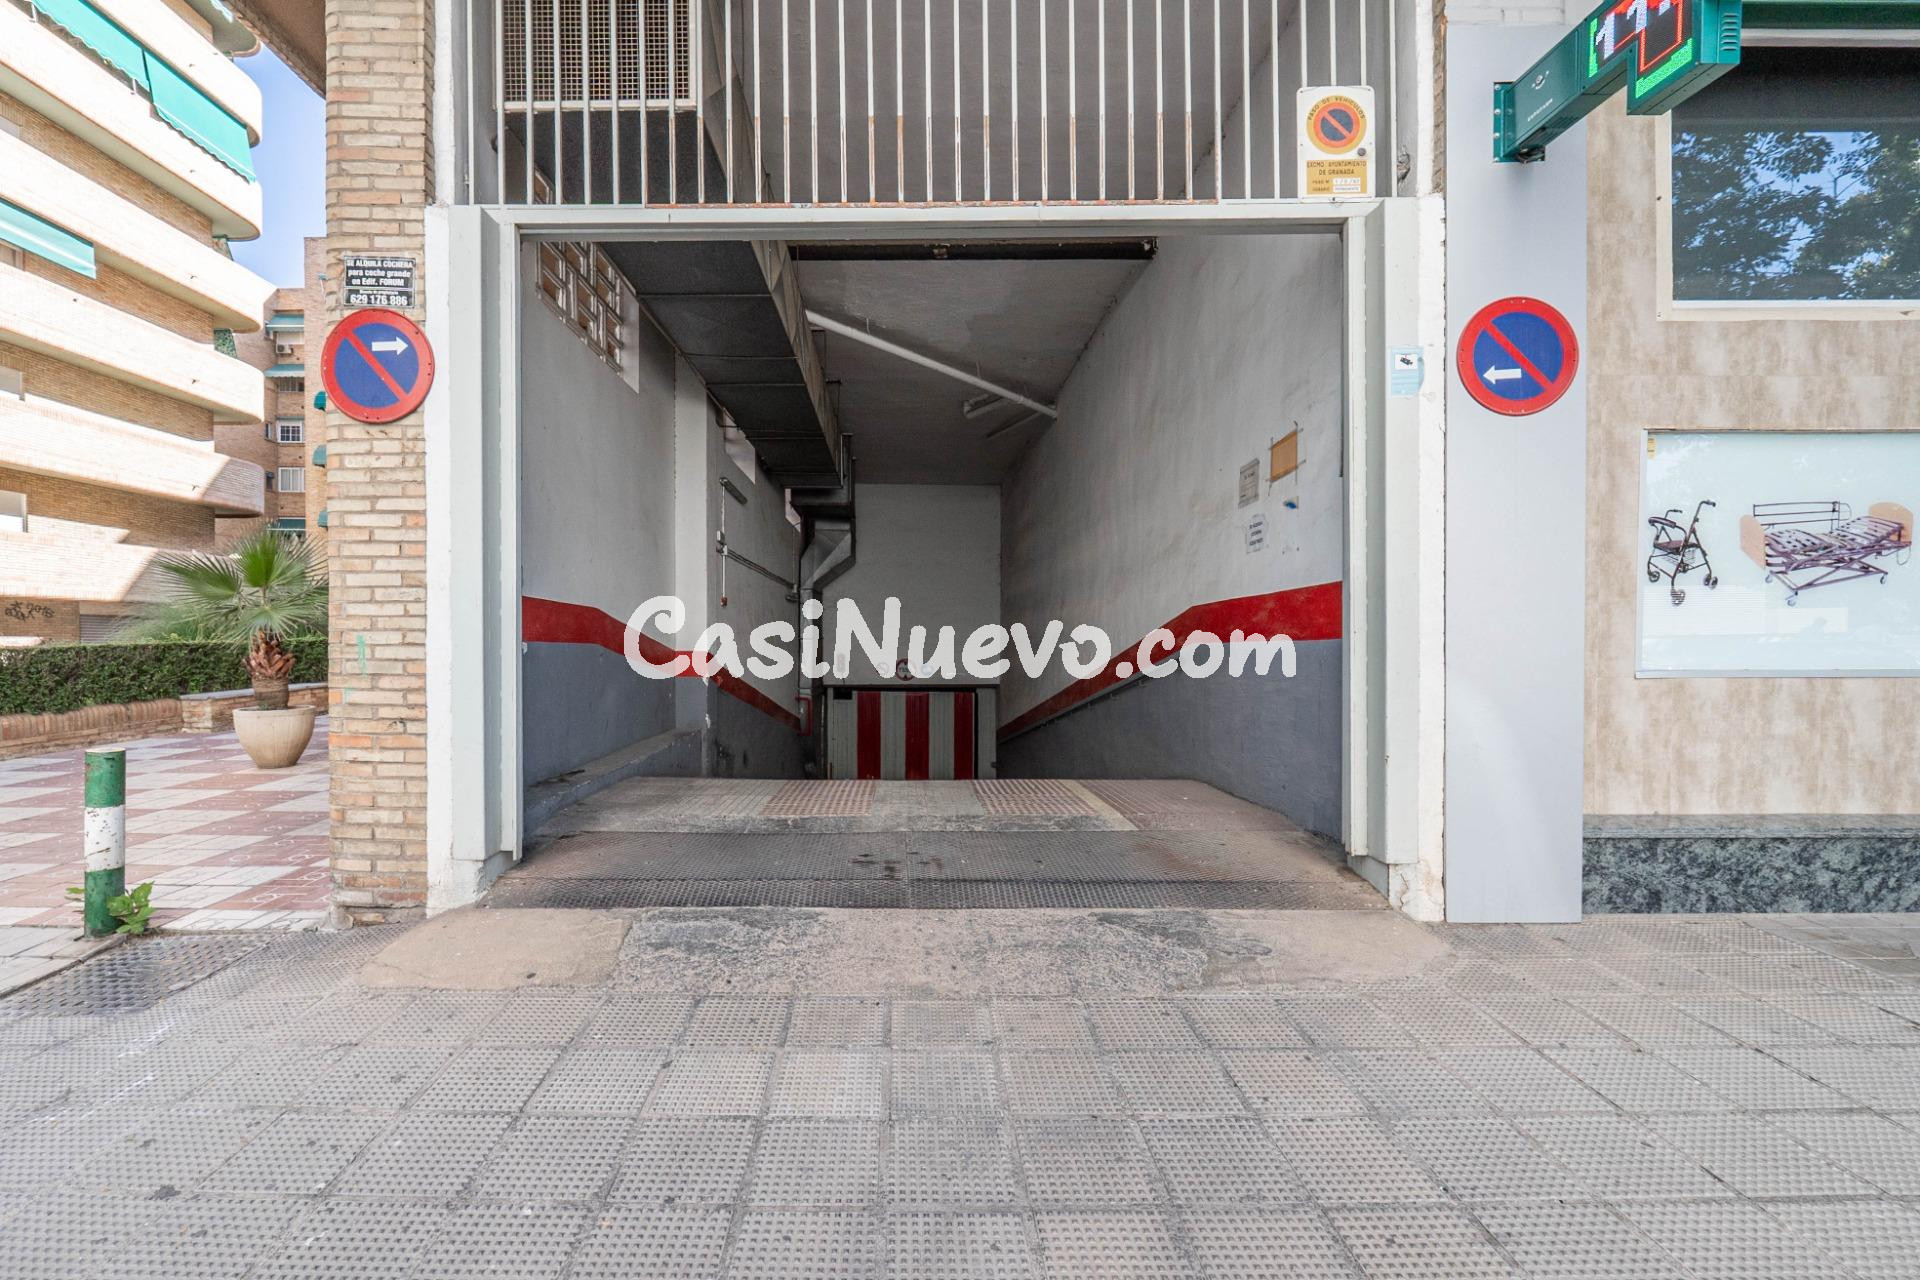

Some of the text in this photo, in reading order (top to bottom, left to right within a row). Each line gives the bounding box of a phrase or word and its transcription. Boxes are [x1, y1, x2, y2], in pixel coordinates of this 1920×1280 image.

[350, 294, 408, 306] 629 176 886
